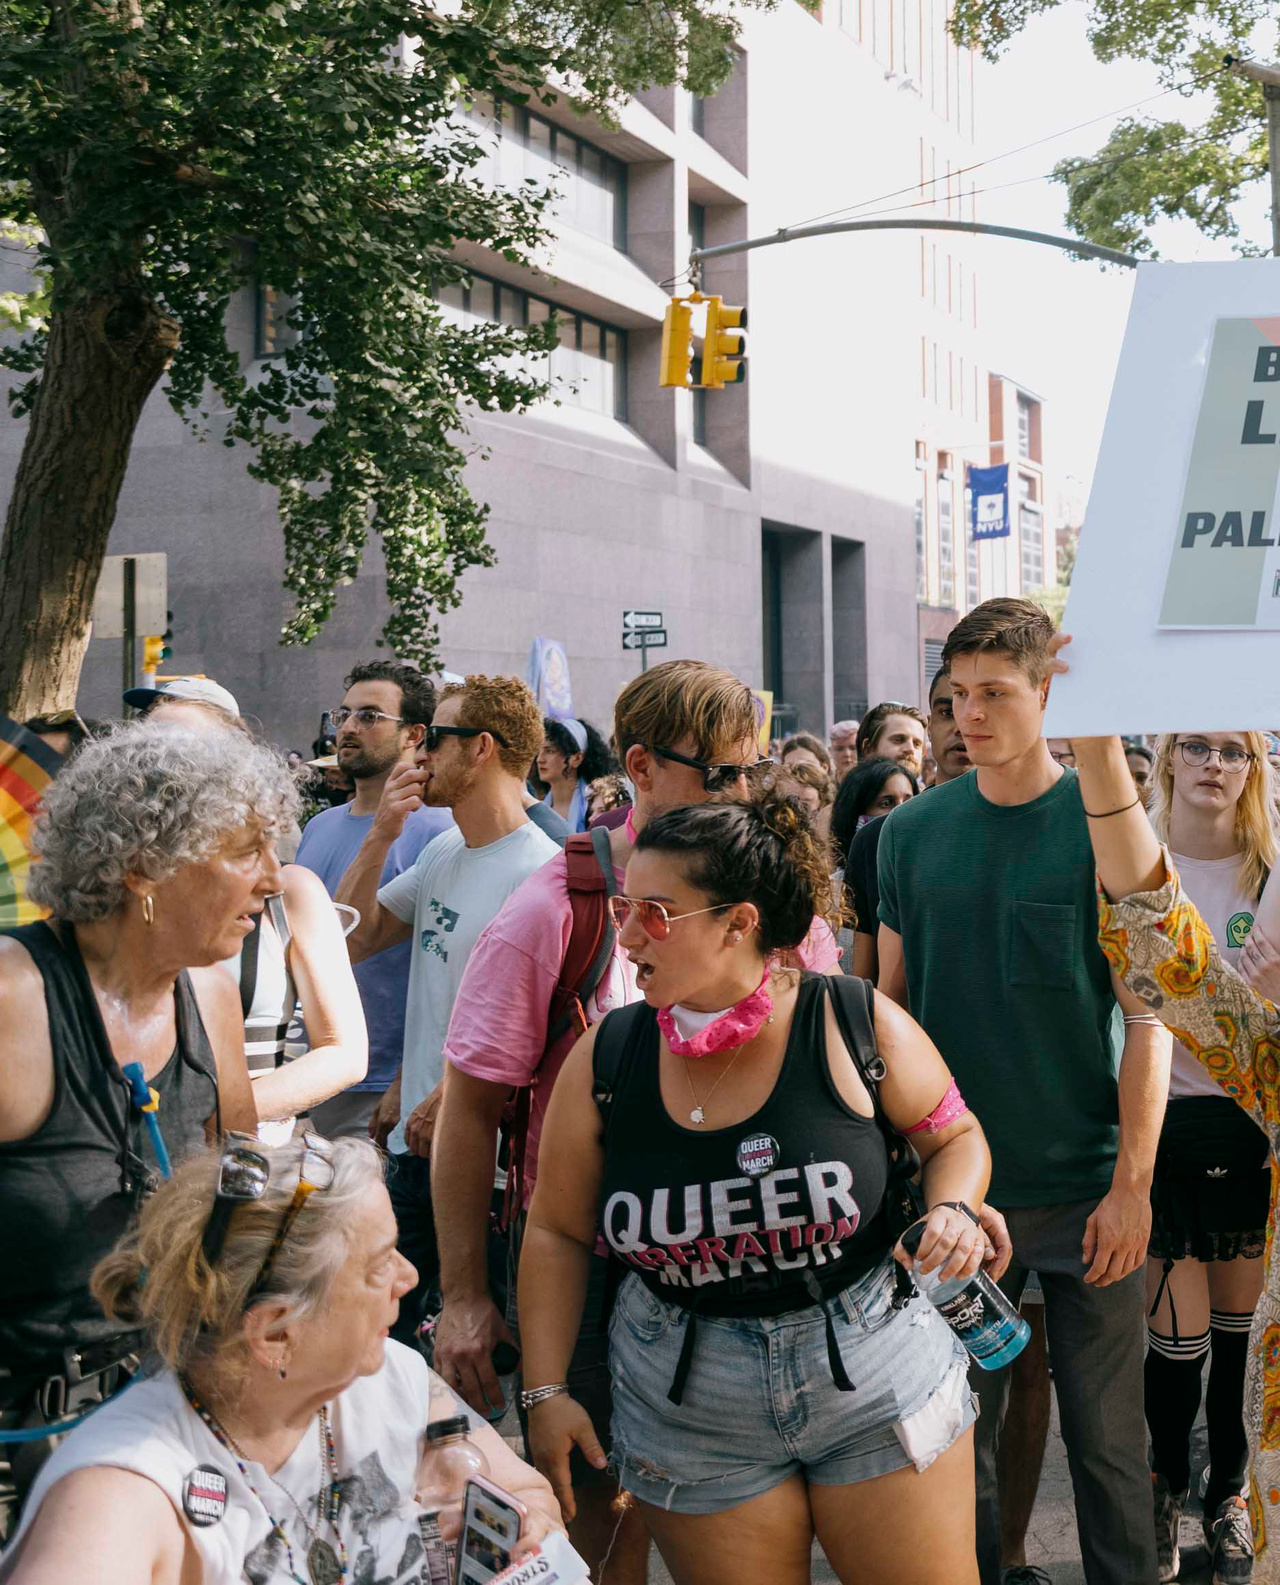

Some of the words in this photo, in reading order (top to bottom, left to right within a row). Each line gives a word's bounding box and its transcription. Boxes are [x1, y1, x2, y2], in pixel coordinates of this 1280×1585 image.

[977, 520, 1004, 532] NYU
[741, 1138, 772, 1154] QUEER
[742, 1155, 774, 1171] MARCH
[604, 1161, 861, 1253] QUEER
[957, 1313, 982, 1330] DRINK
[503, 1556, 550, 1585] STRU
